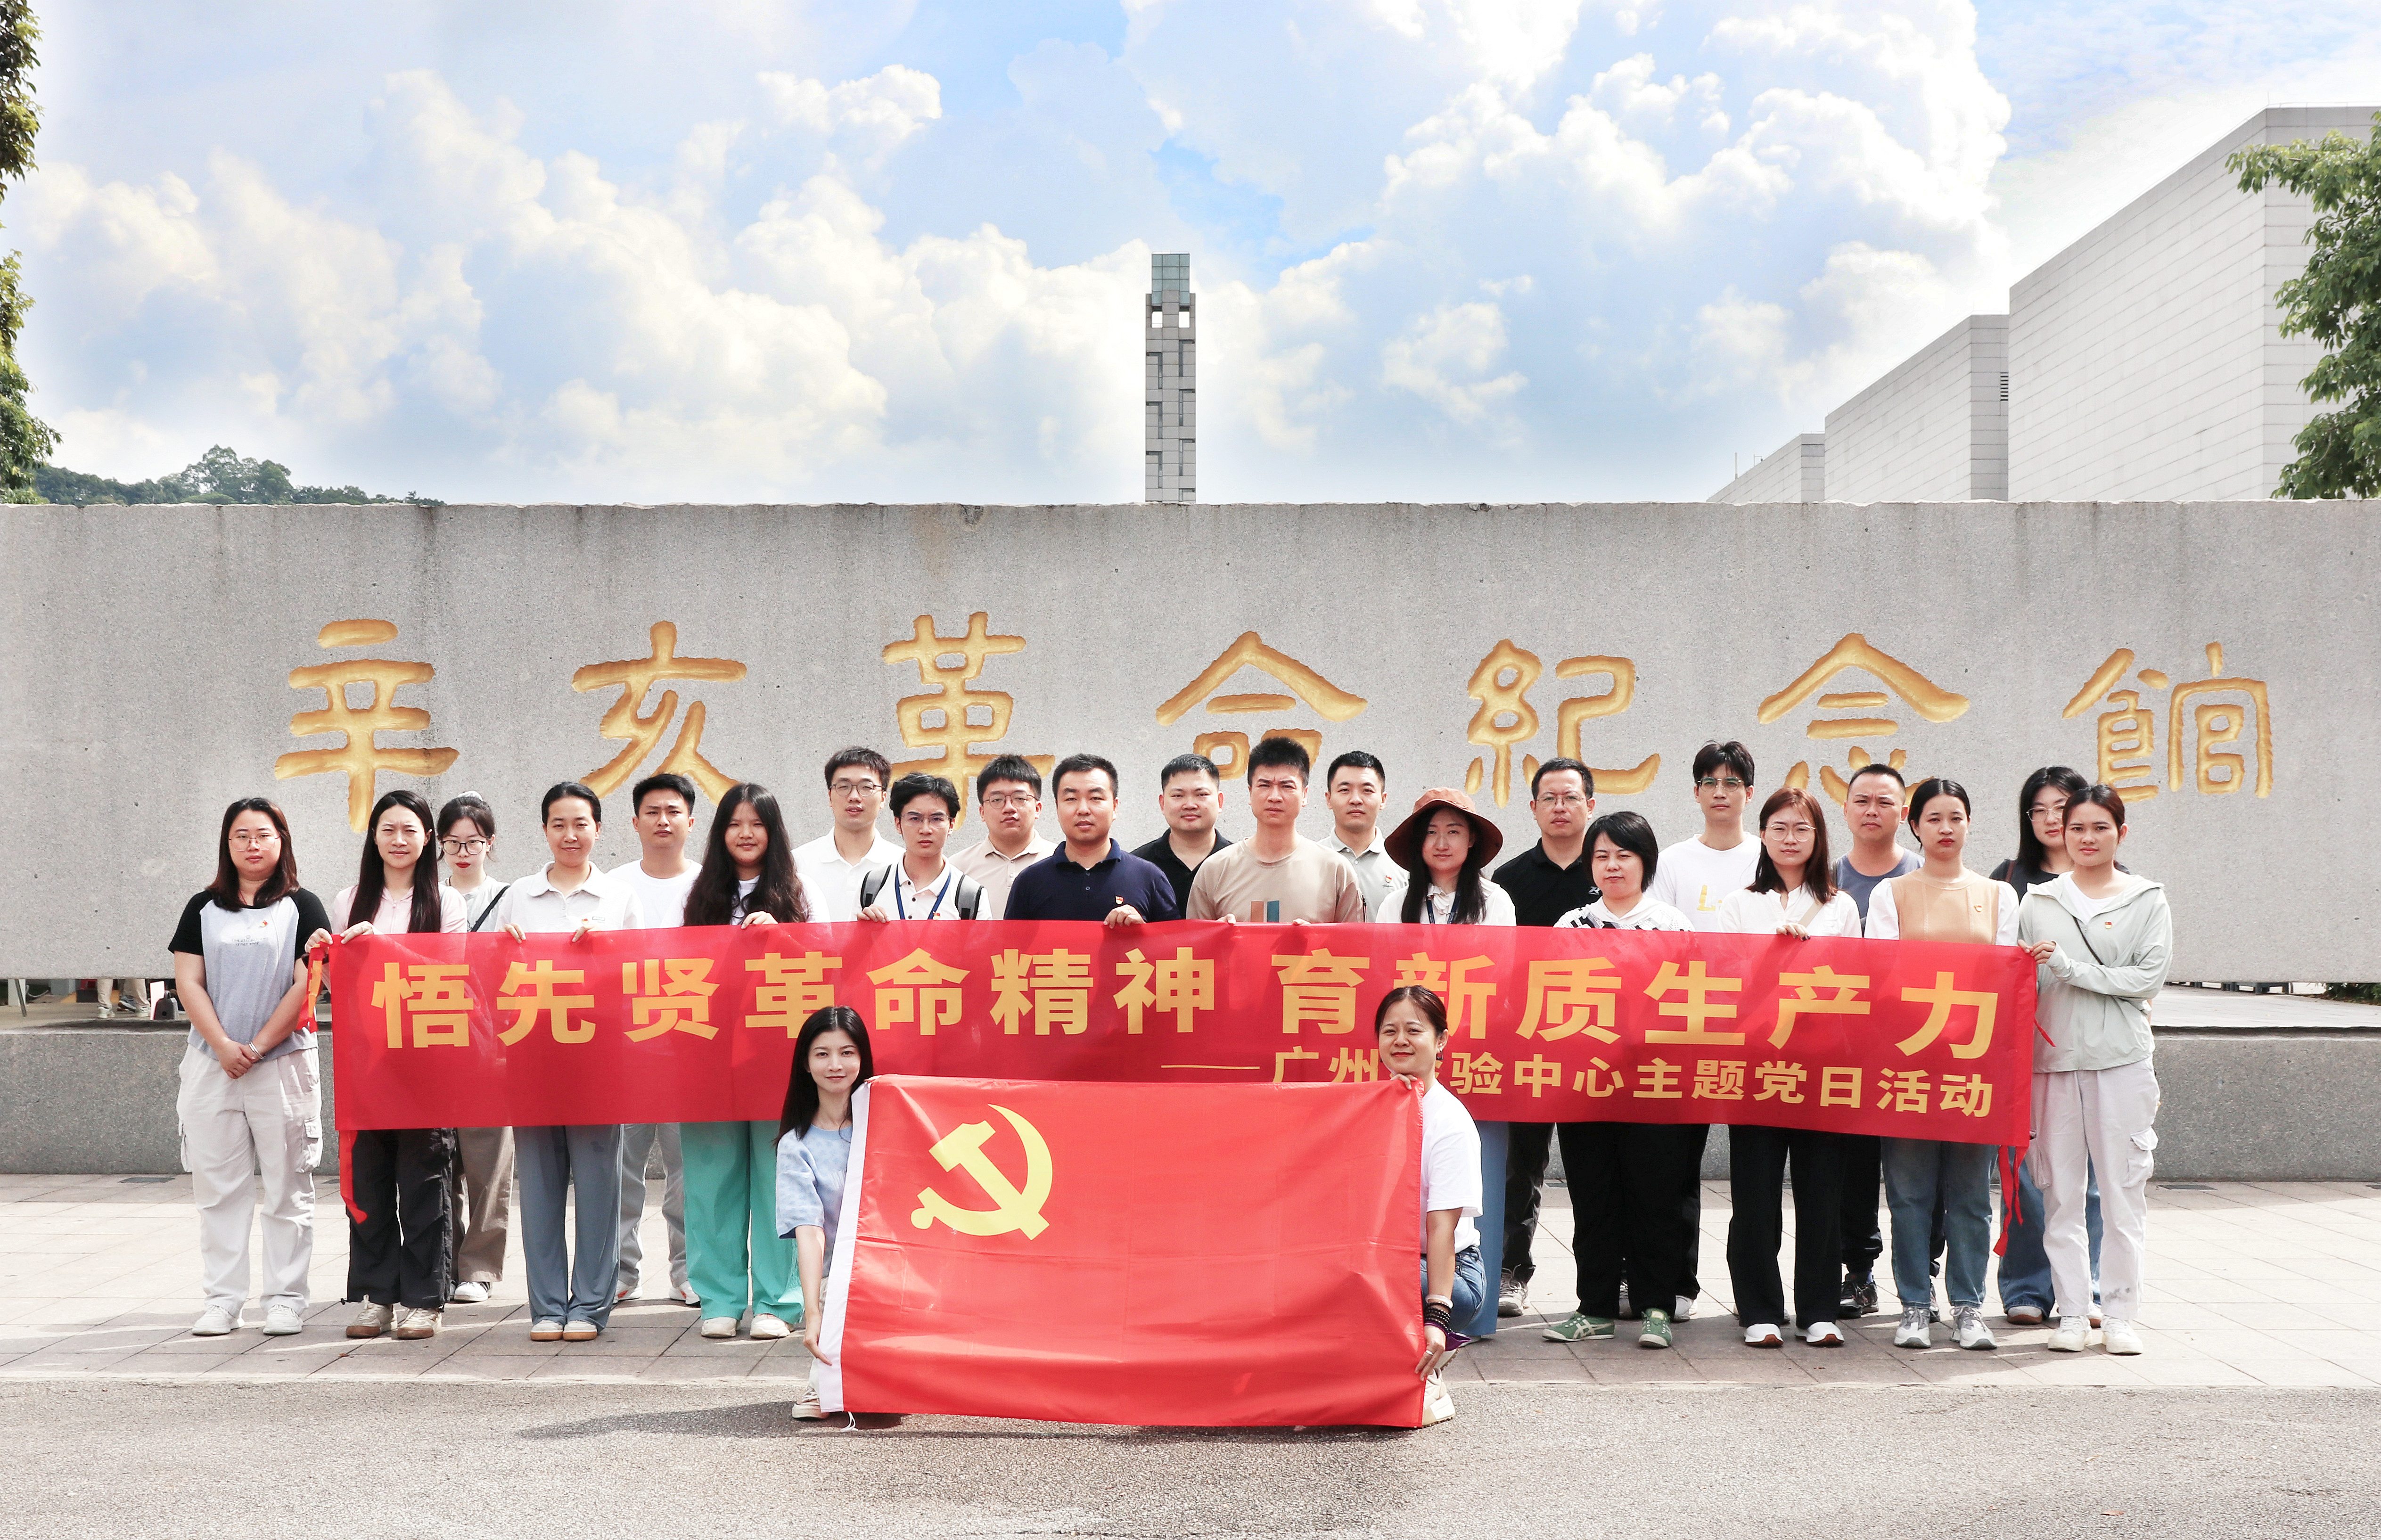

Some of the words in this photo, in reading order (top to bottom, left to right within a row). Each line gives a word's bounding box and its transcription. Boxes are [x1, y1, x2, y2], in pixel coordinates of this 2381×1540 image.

[274, 612, 2272, 833] 辛亥革命紀念館
[370, 946, 1215, 1049] 悟先贤革命精神
[1271, 948, 1998, 1059] 育新质生产力
[1161, 1046, 1993, 1117] ——广州验中心主题党日活动
